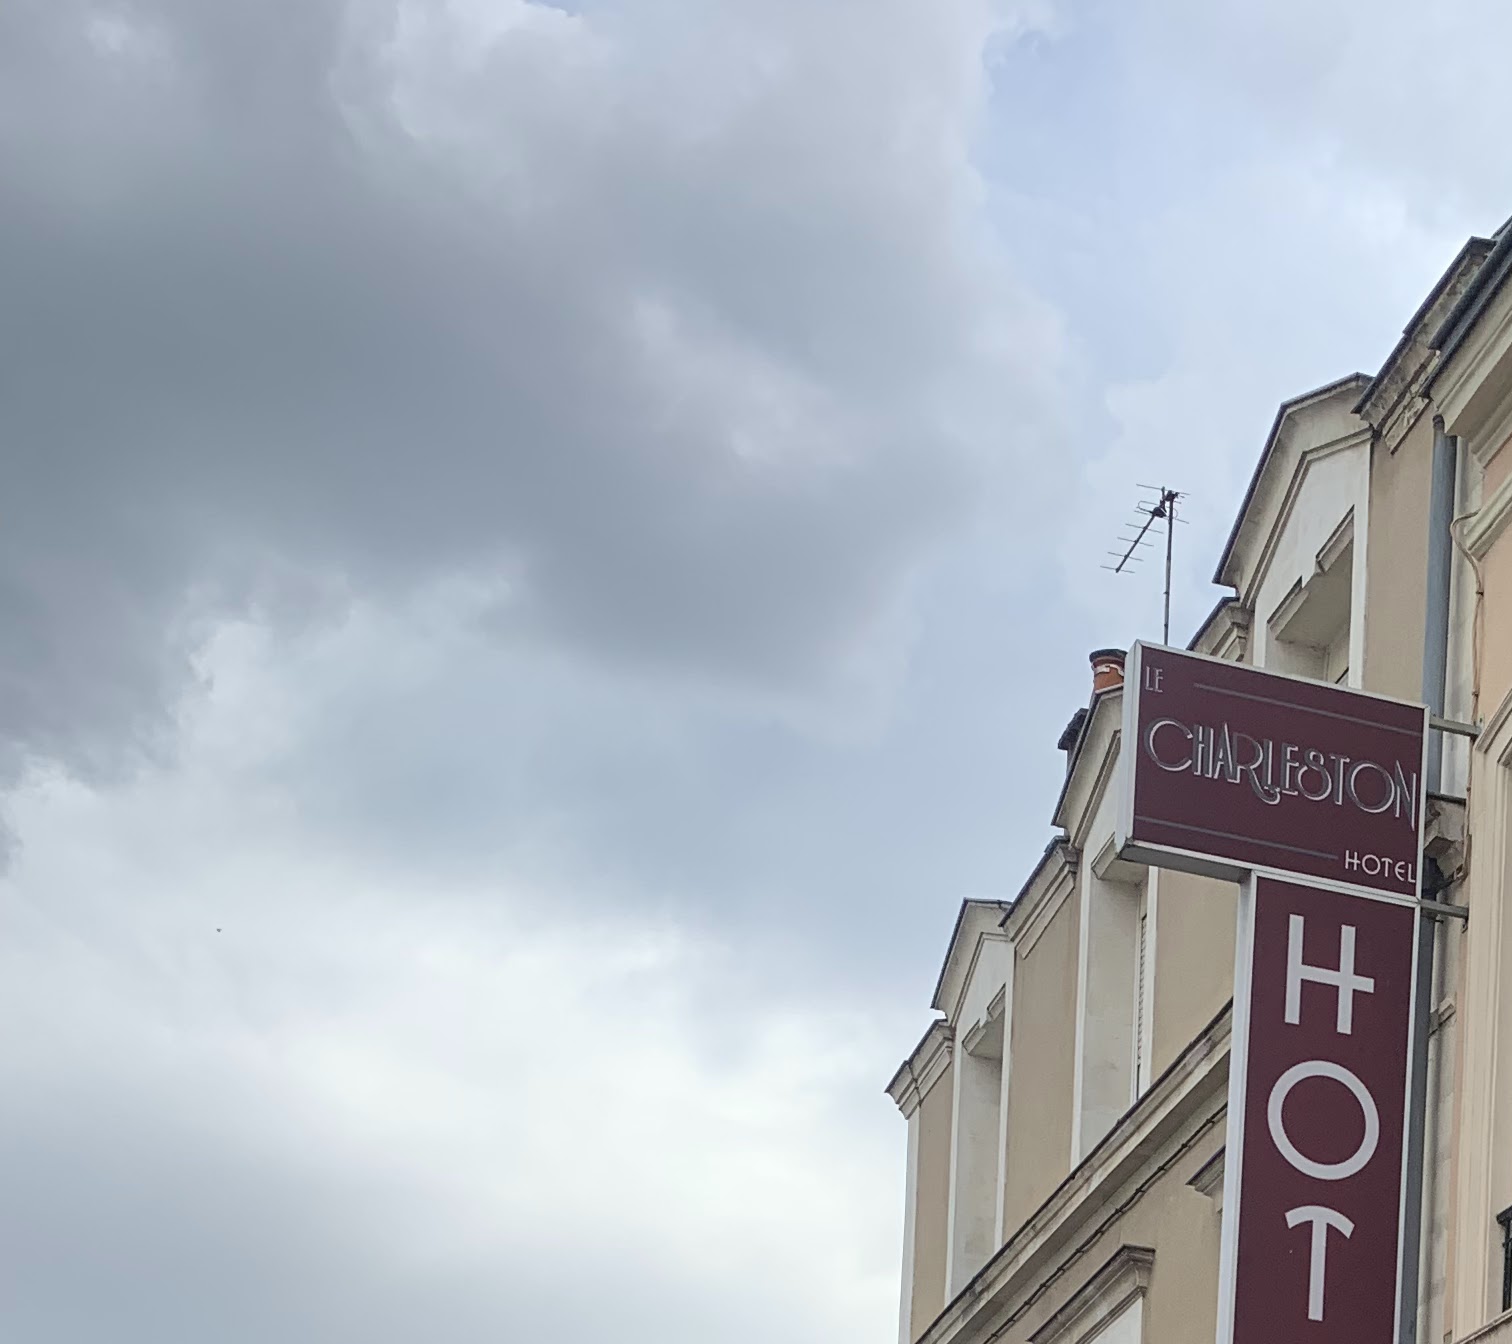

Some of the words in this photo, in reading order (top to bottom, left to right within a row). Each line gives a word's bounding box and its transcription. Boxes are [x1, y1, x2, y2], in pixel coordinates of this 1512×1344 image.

[1145, 666, 1163, 693] LE
[1144, 717, 1417, 831] CHARLESTON
[1344, 850, 1416, 883] HOTEL
